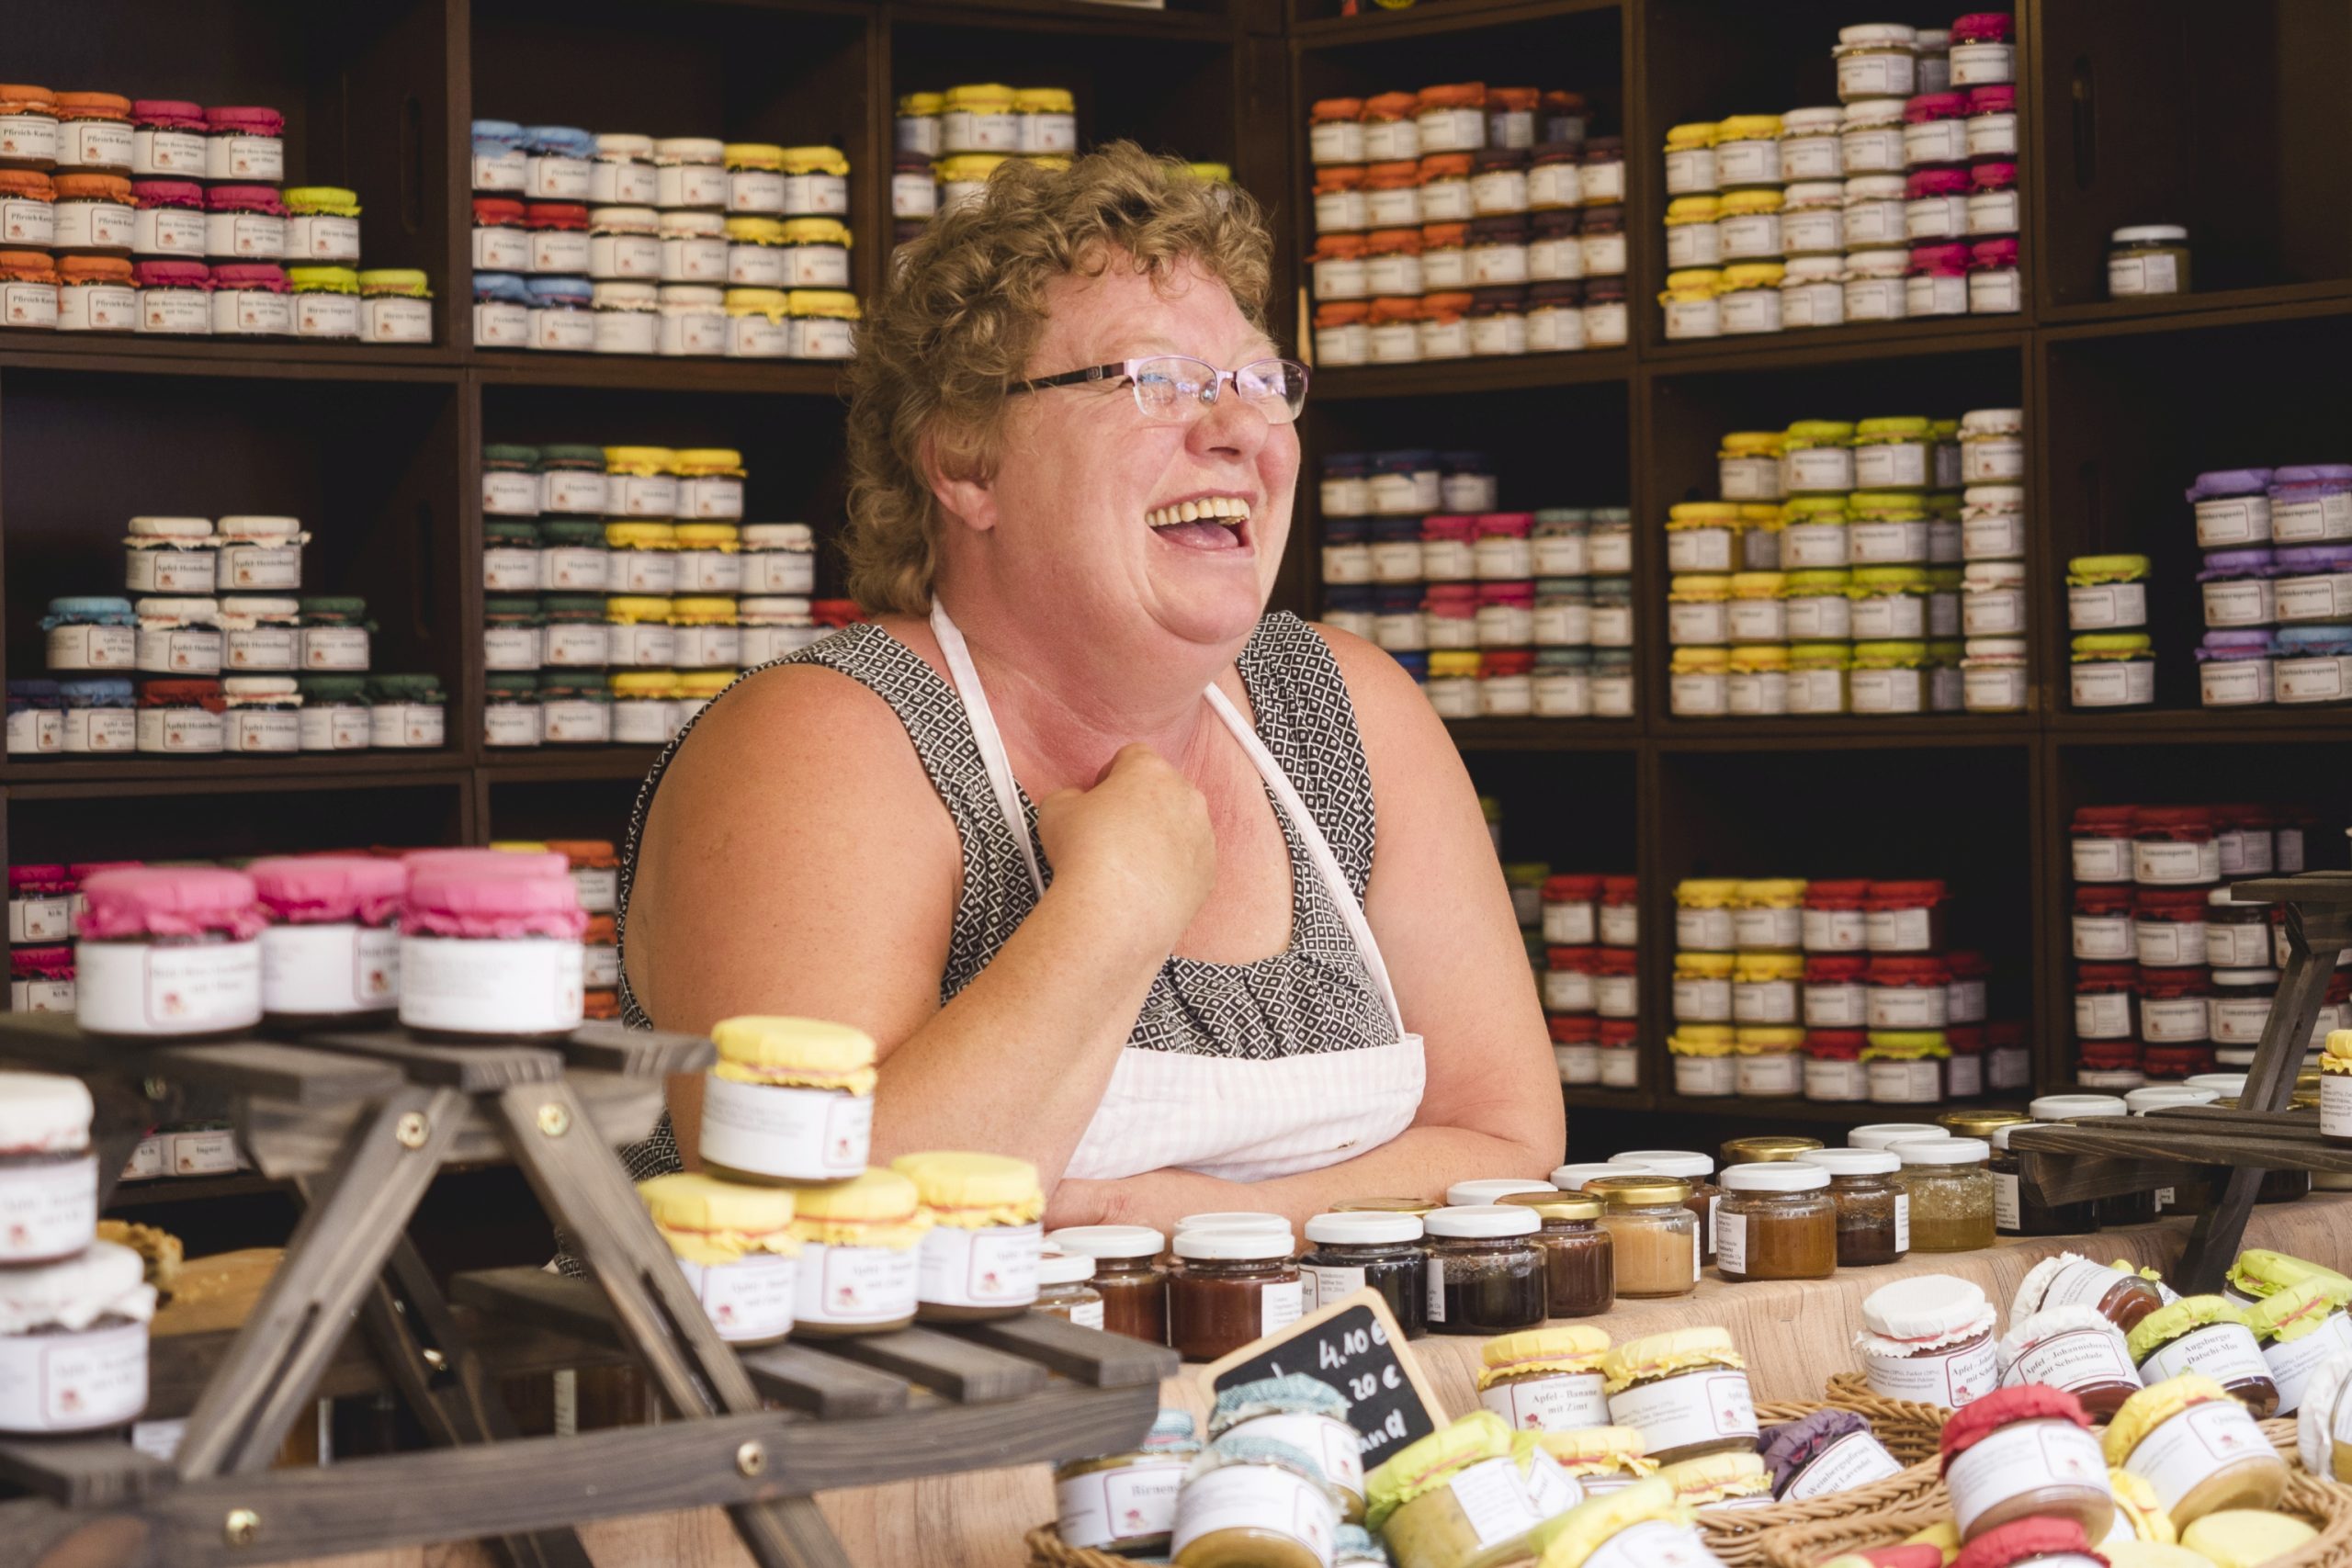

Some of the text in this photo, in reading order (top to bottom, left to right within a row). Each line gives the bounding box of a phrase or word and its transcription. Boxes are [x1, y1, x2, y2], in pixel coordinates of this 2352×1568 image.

[1318, 1328, 1370, 1370] 4.10
[2184, 1333, 2232, 1354] Augsburger
[1951, 1362, 1973, 1377] Apfel
[2025, 1357, 2046, 1375] Apfel
[2039, 1352, 2103, 1378] mit Schokolade
[1382, 1364, 1402, 1389] €
[1532, 1391, 1558, 1404] Apfel
[1566, 1388, 1598, 1398] Banane
[1547, 1402, 1589, 1415] mit Zimt
